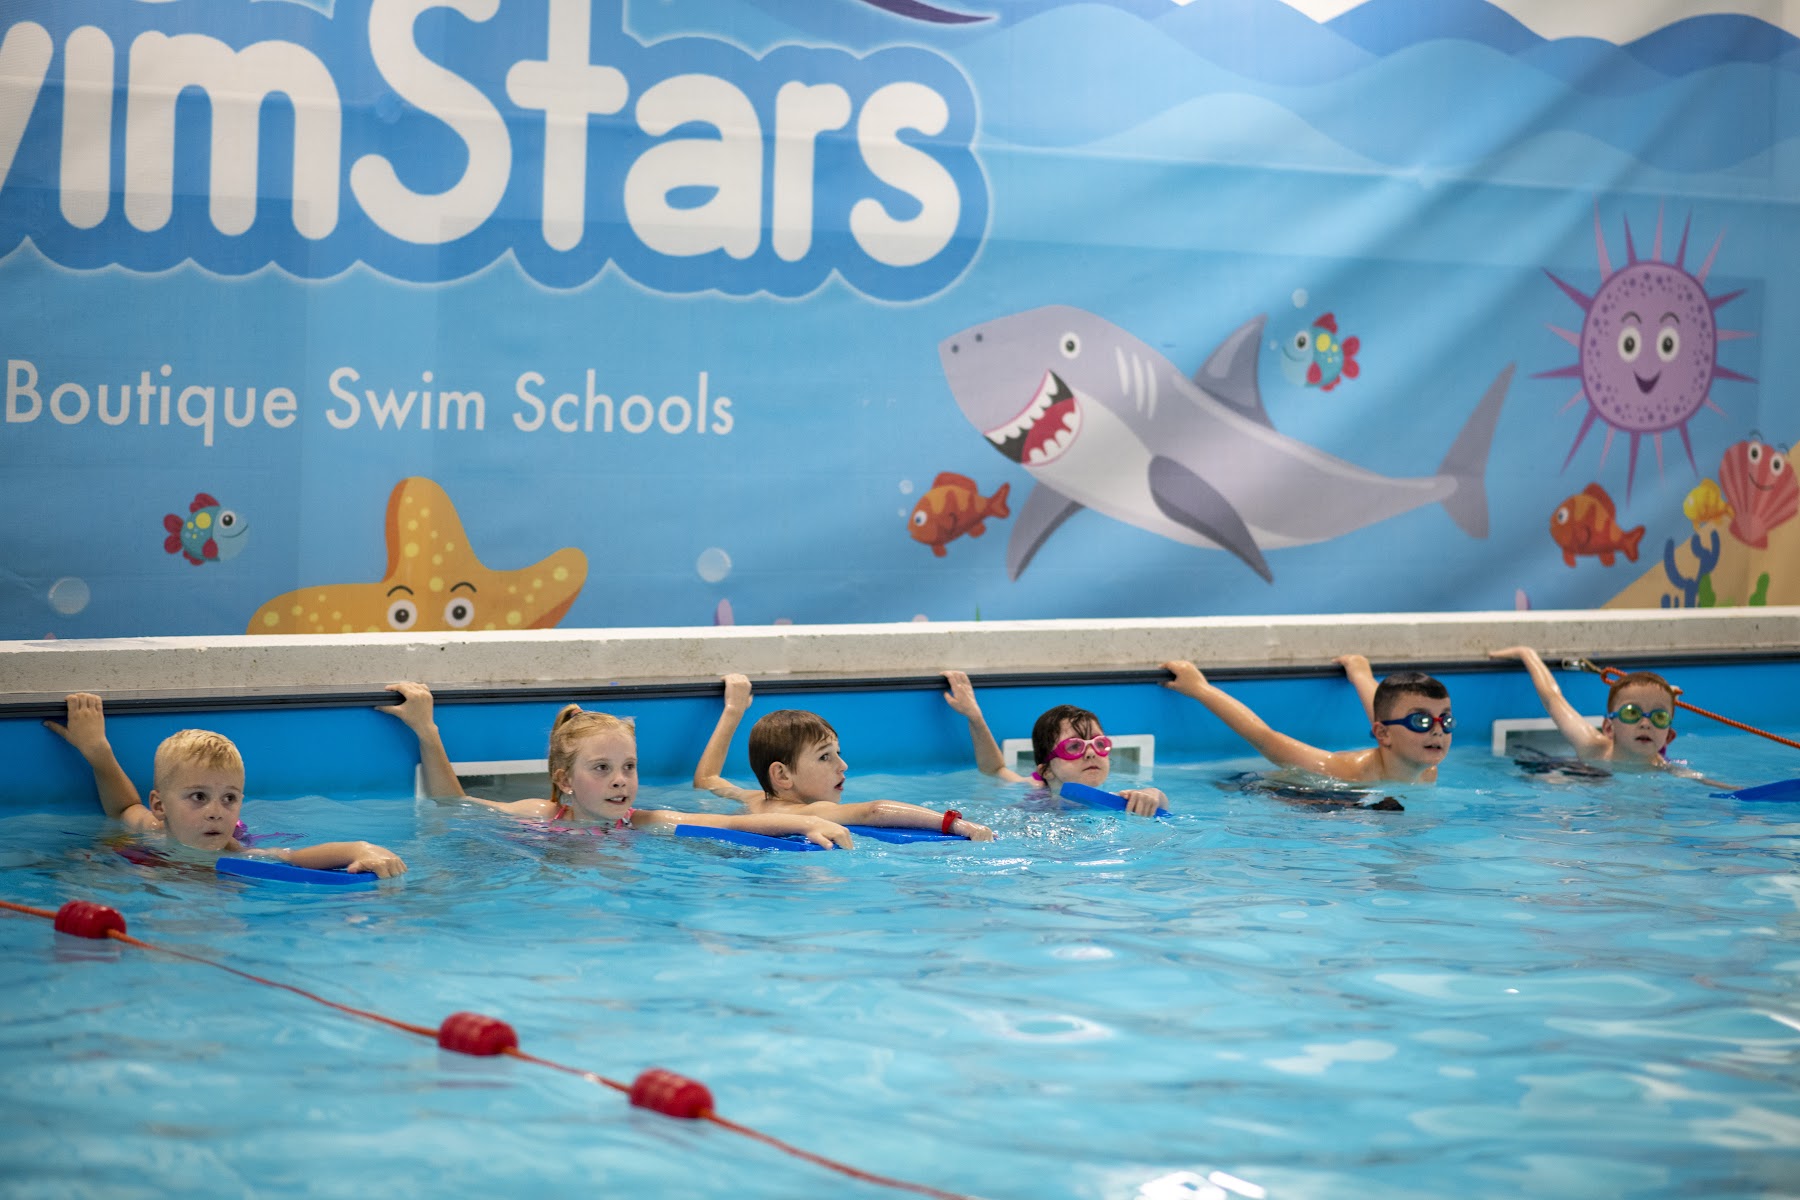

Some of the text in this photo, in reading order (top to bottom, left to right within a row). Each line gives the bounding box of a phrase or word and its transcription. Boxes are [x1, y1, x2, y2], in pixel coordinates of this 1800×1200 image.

[0, 0, 961, 267] imStars
[5, 359, 735, 447] Boutique Swim Schools
